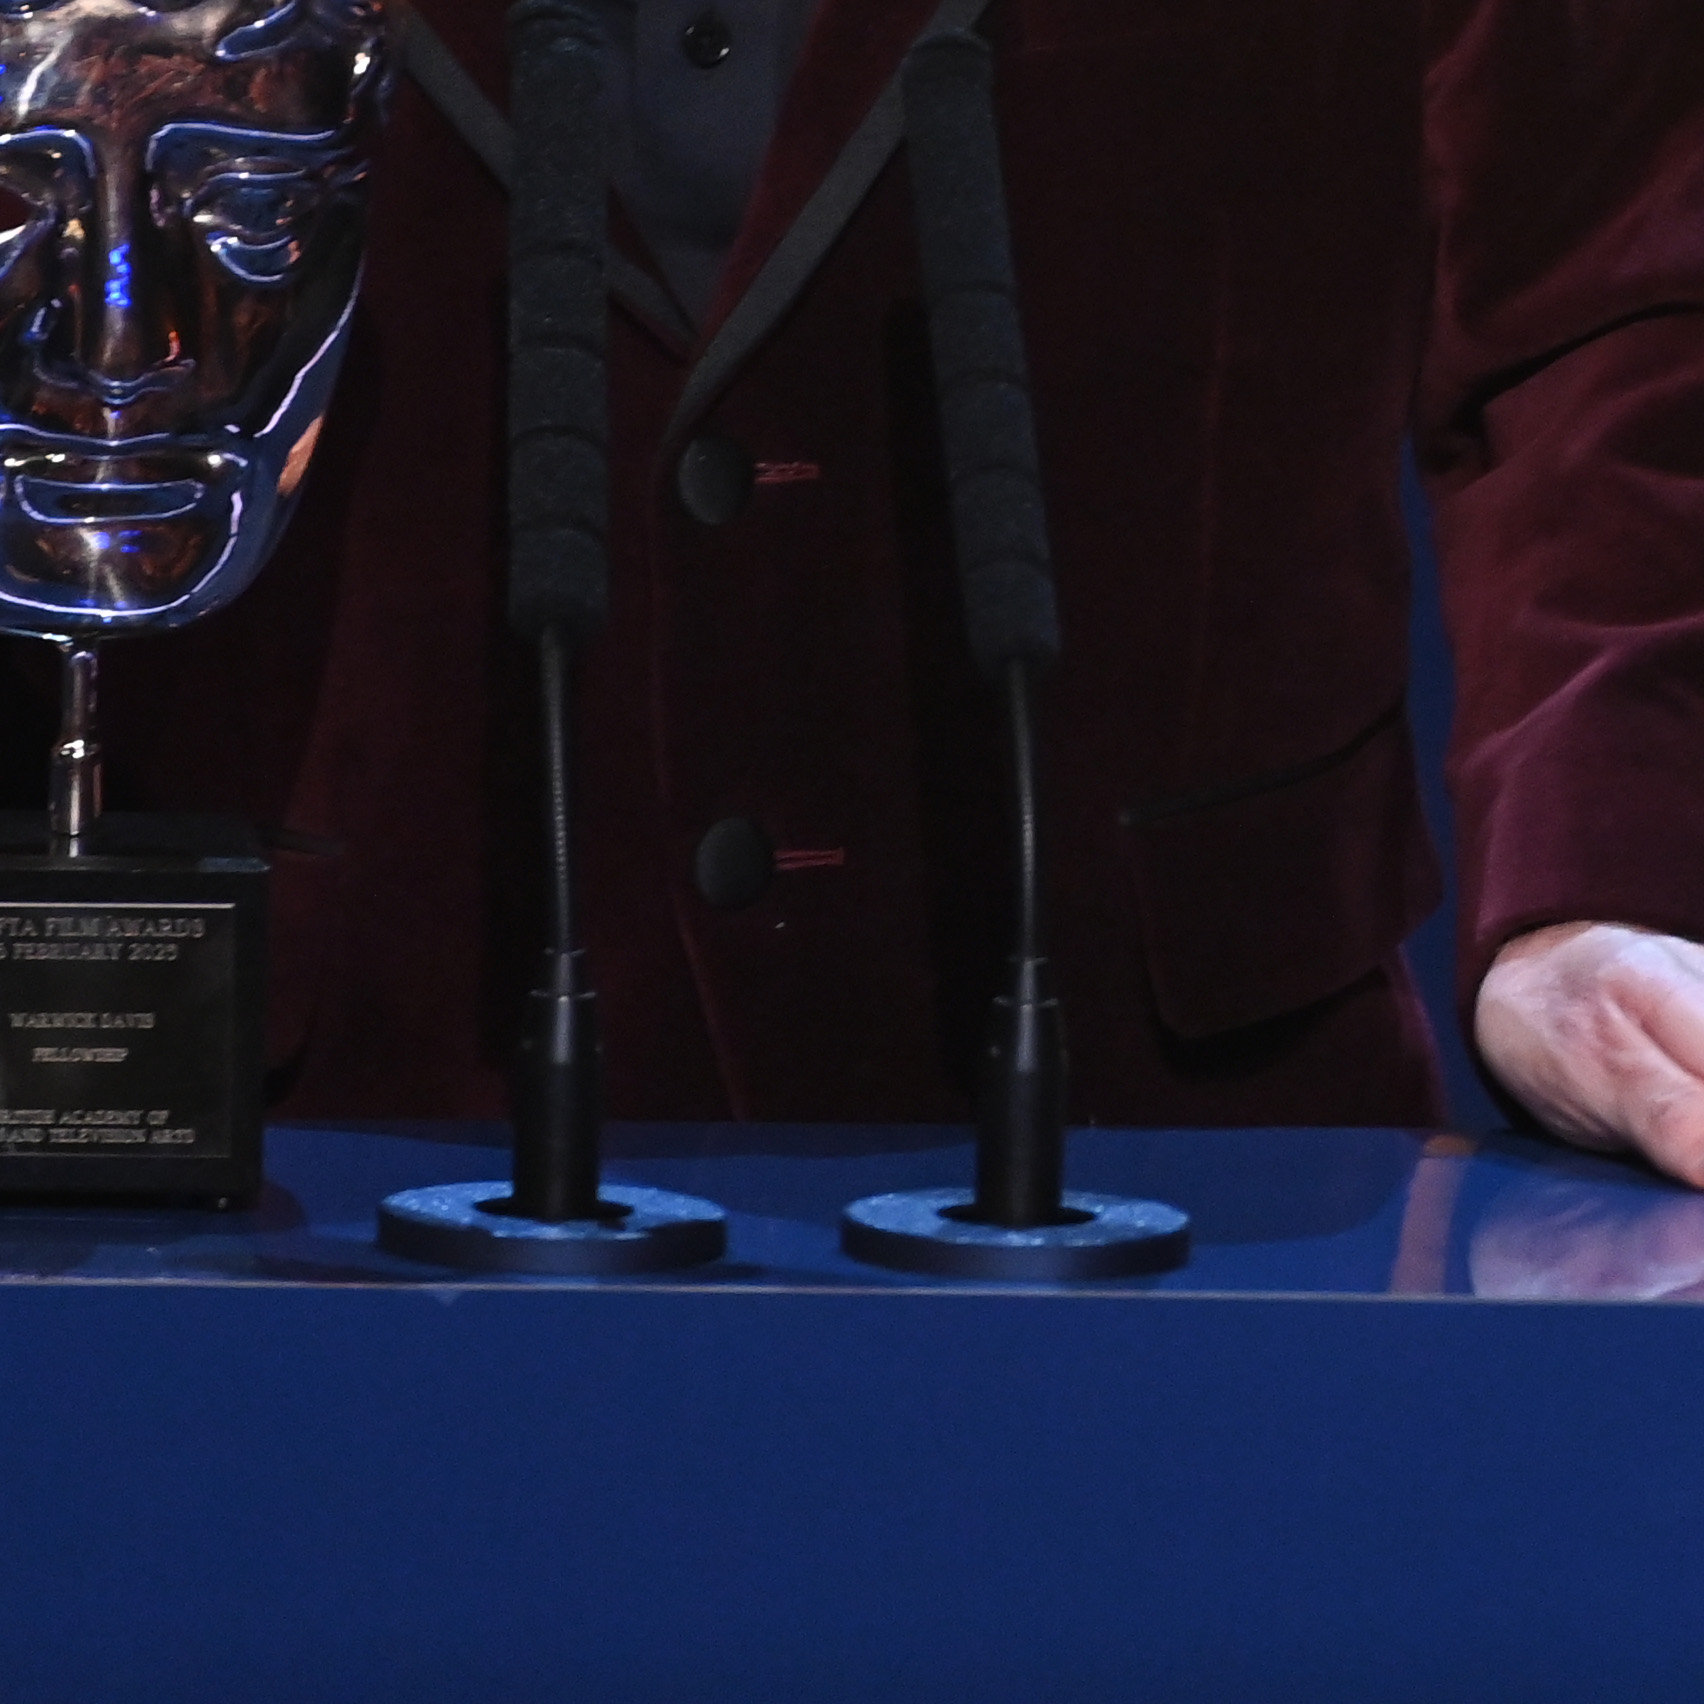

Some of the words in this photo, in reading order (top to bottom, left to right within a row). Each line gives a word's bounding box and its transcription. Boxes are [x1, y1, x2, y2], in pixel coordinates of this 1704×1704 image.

[44, 916, 100, 937] FILM
[105, 916, 207, 938] AWARDS
[12, 942, 123, 961] FEBRUARY
